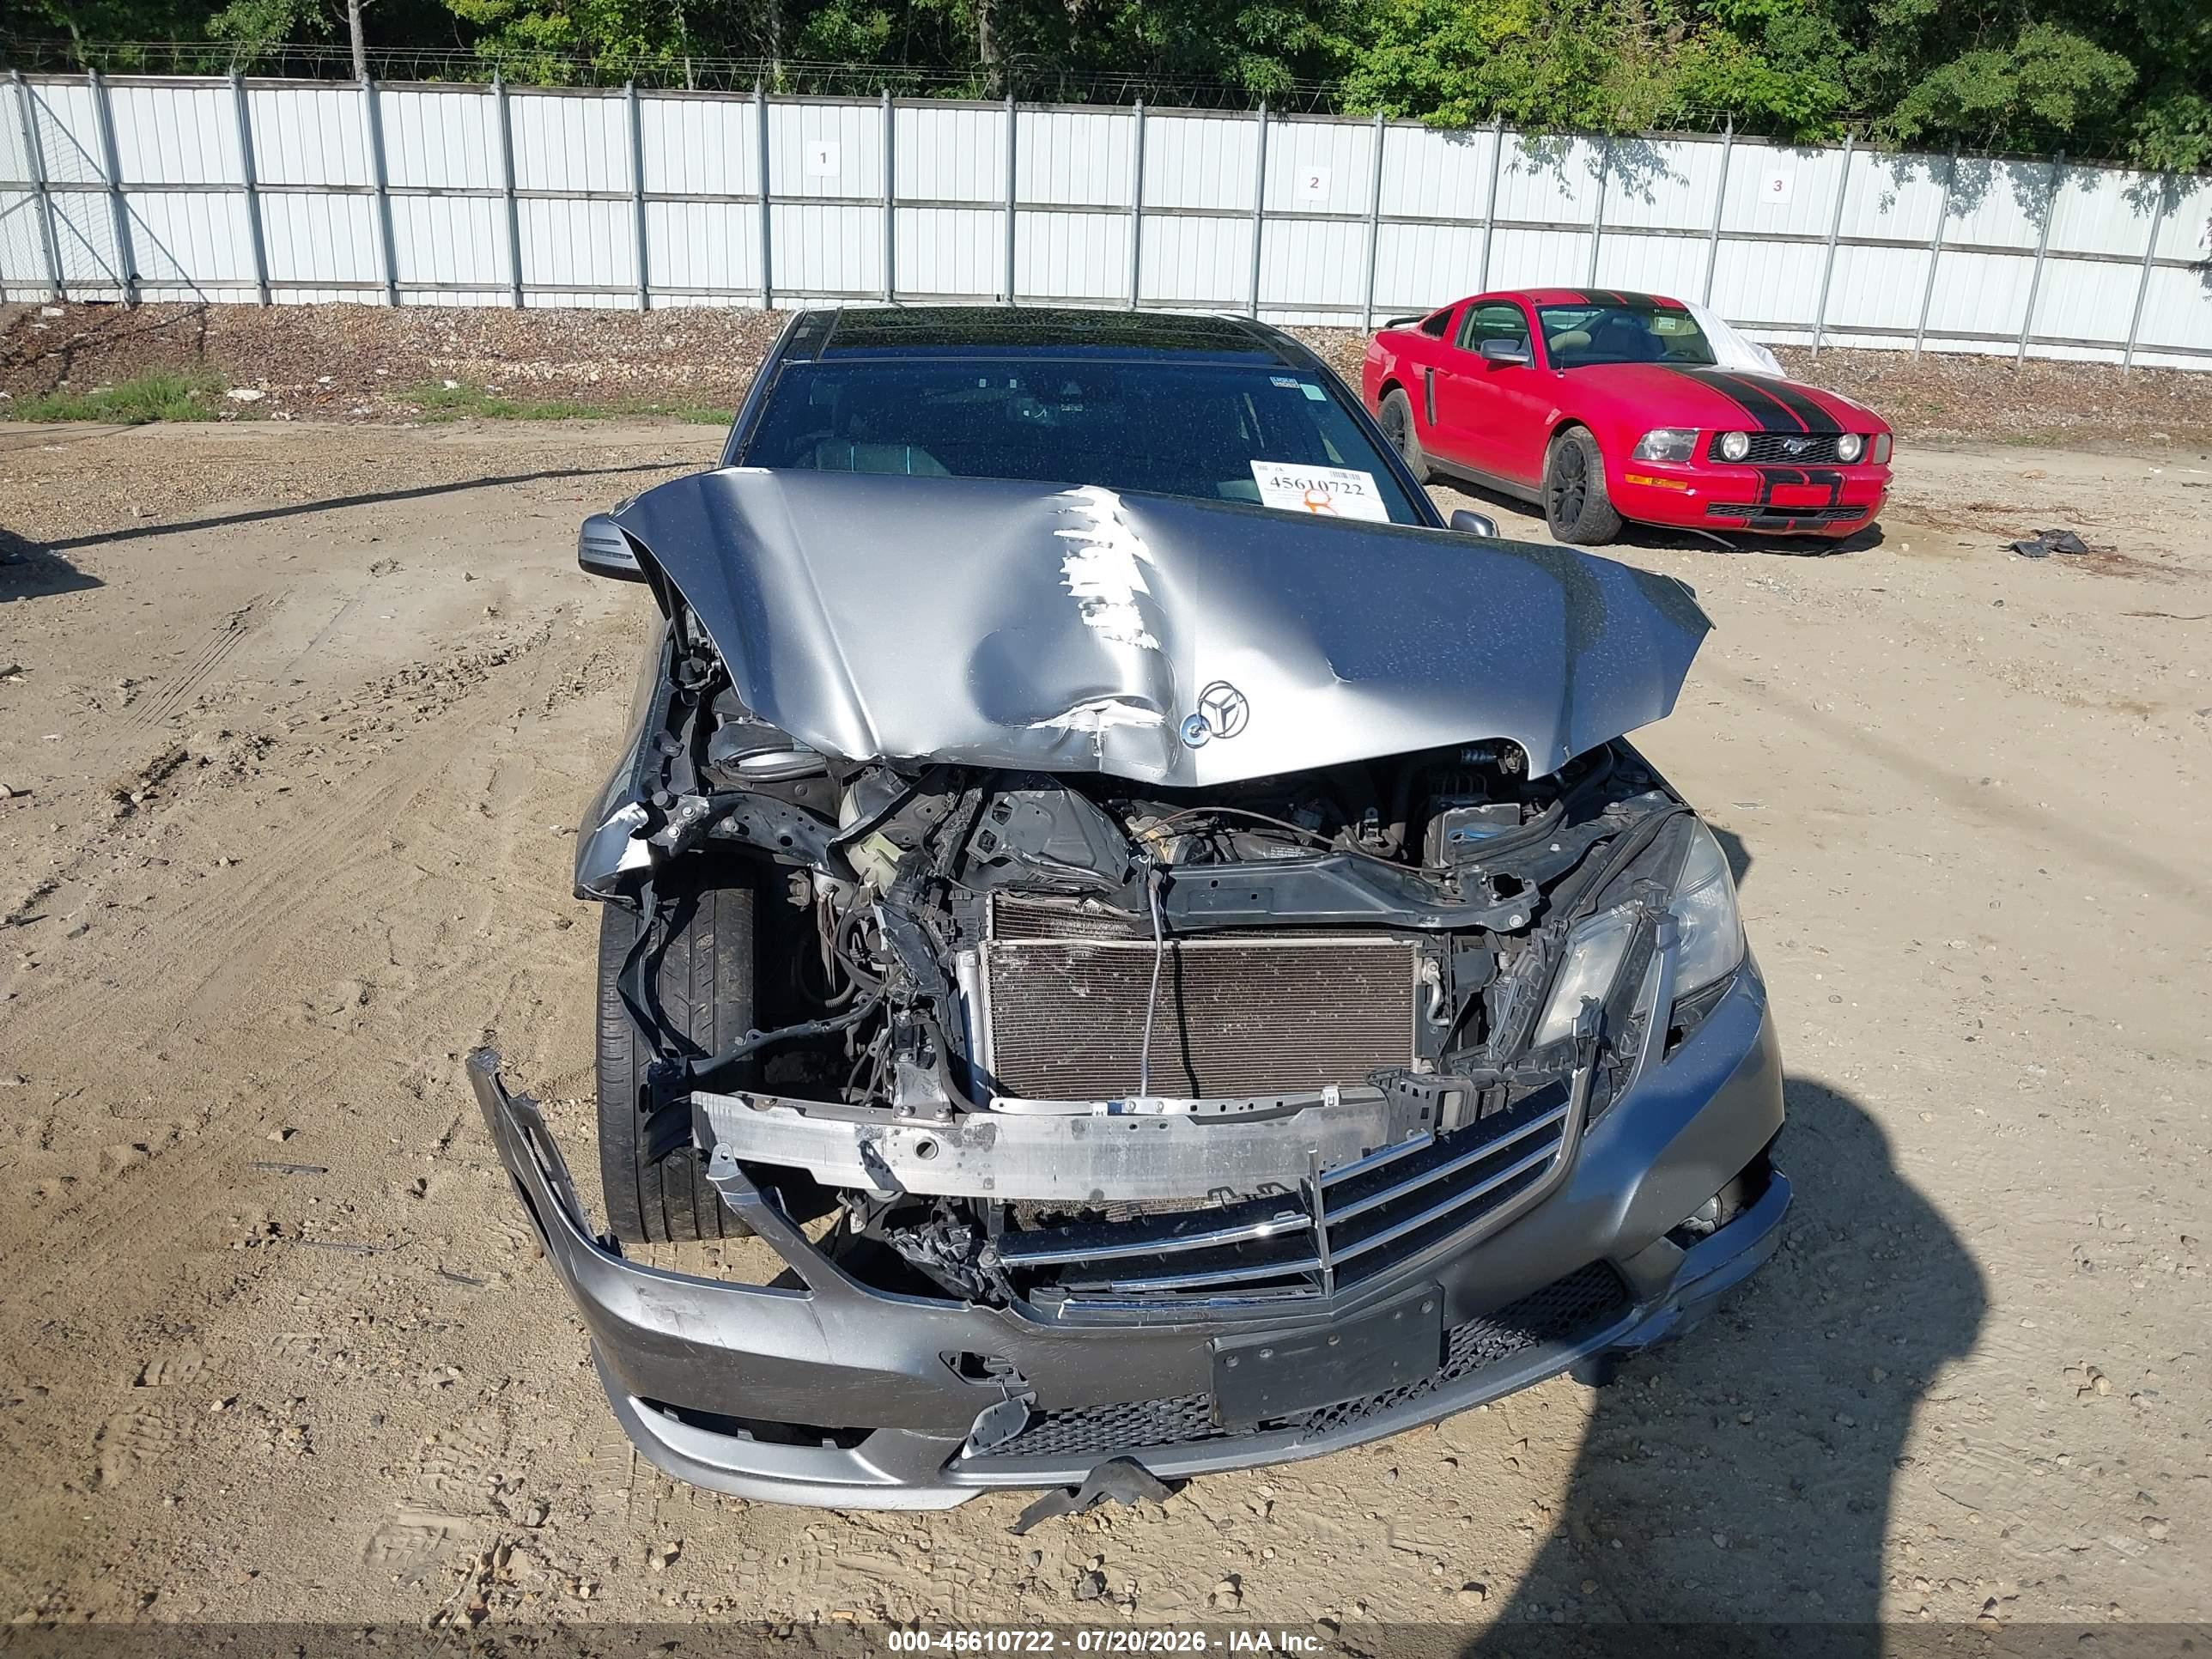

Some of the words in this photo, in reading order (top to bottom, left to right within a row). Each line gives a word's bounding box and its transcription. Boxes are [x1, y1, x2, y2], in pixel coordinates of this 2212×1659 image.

[819, 152, 827, 164] 1
[1310, 177, 1320, 189] 2
[1772, 179, 1784, 192] 3
[1270, 476, 1365, 495] 45610722
